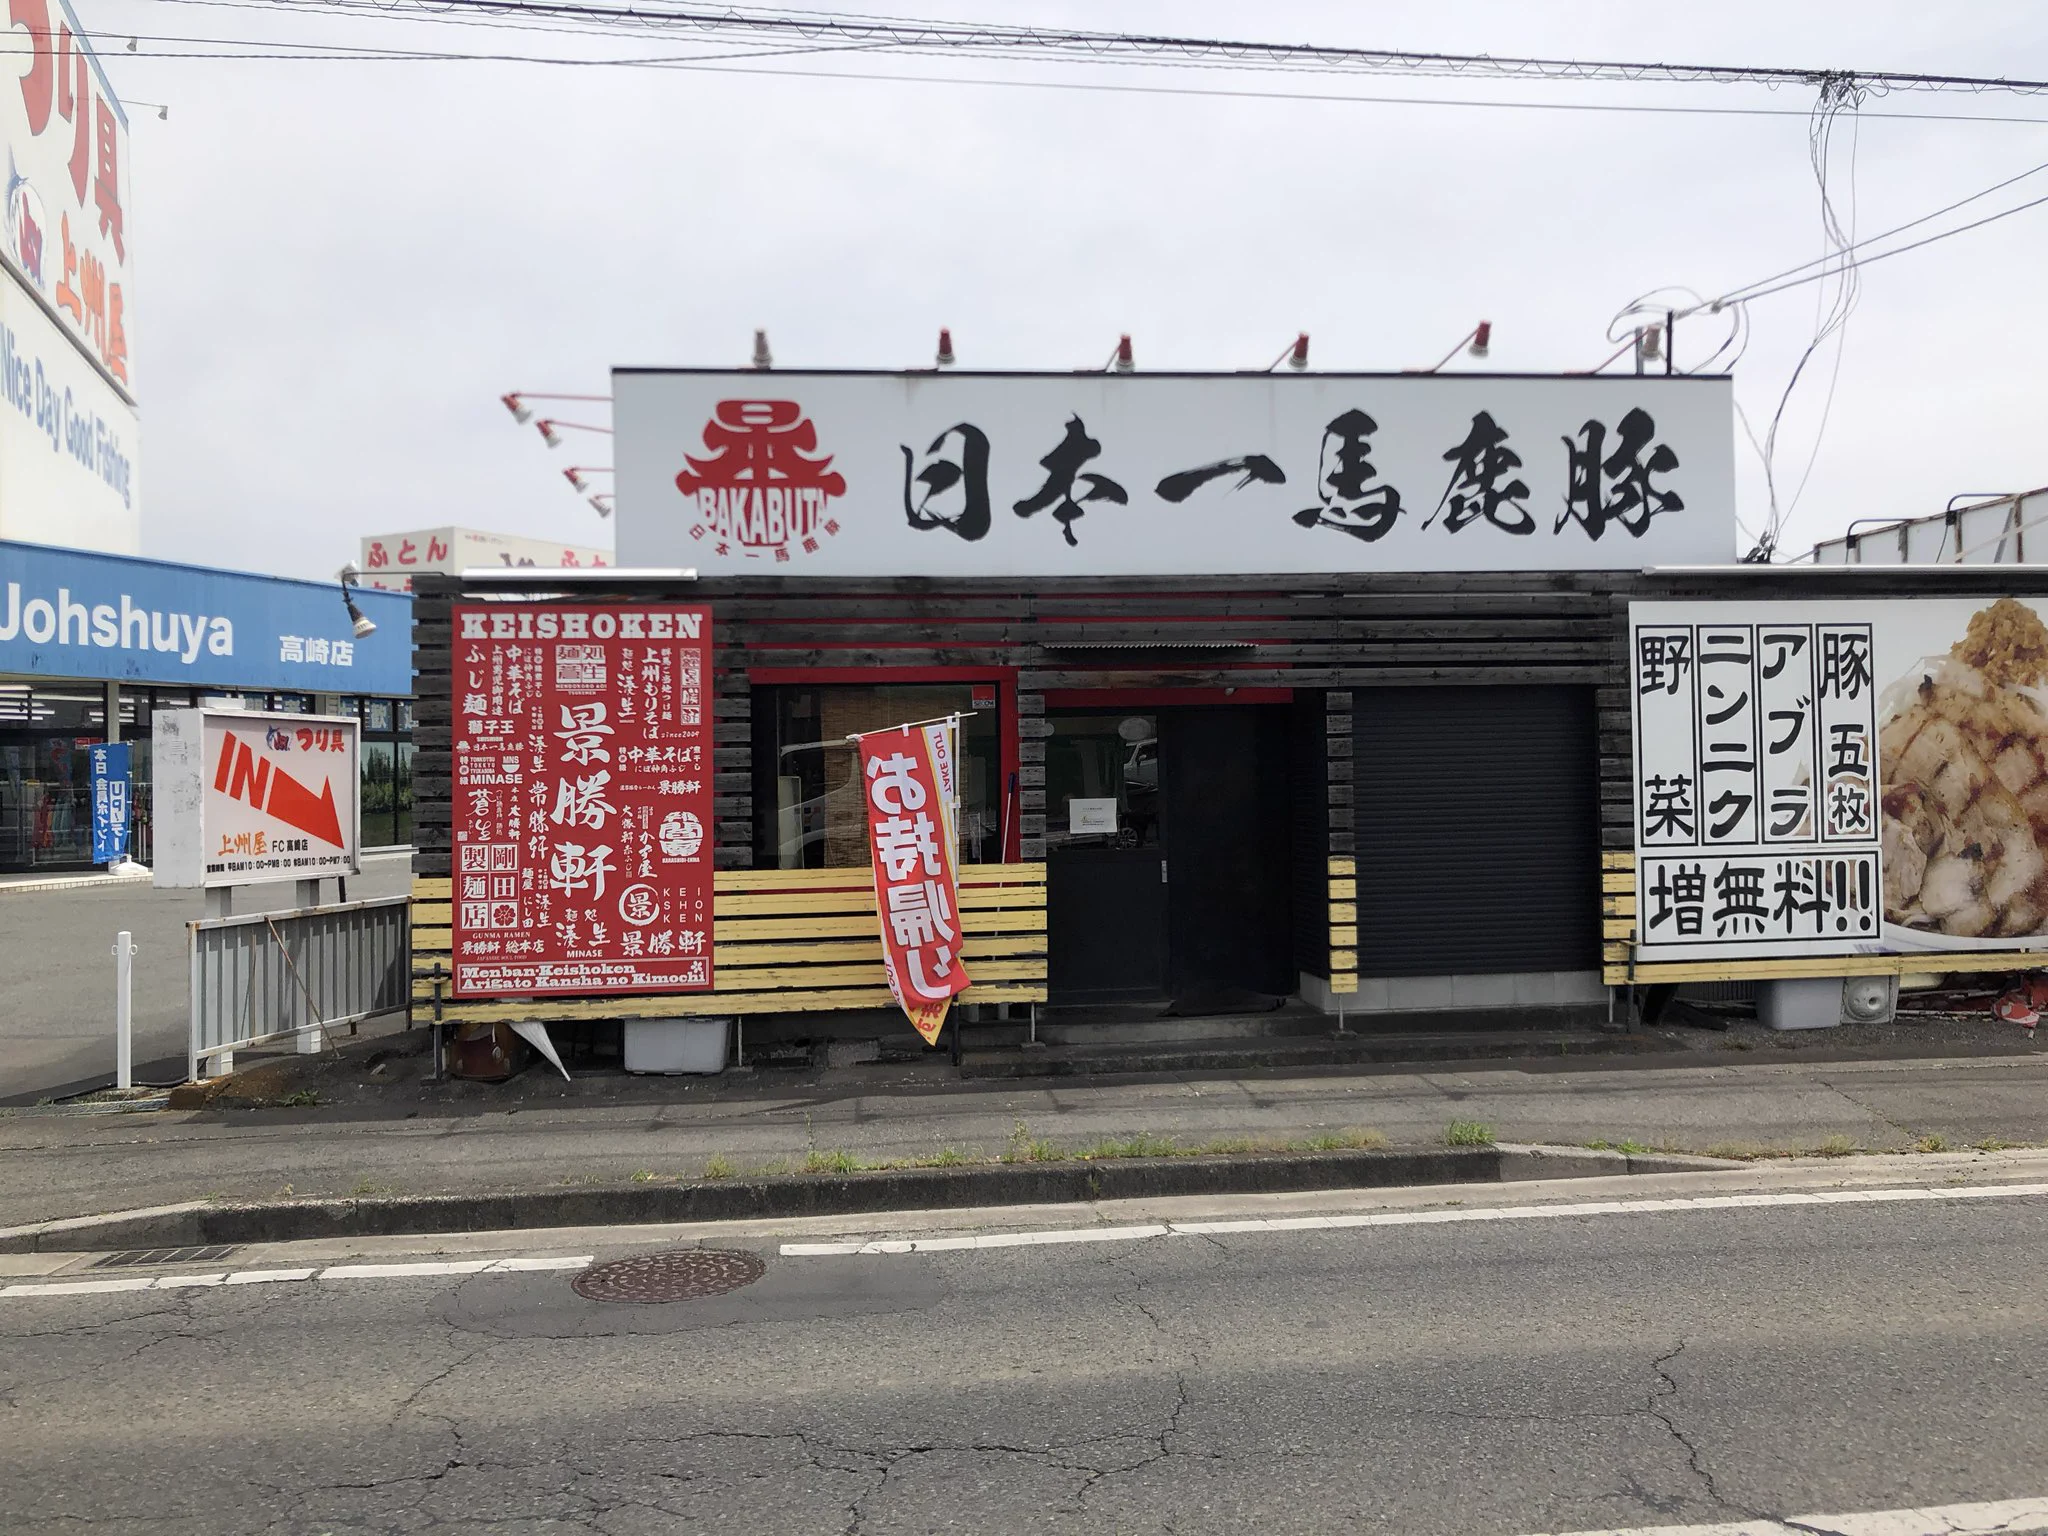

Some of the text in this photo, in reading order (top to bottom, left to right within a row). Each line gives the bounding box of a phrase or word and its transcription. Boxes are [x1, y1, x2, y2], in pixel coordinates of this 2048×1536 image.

[56, 210, 128, 386] 上州屋
[0, 320, 31, 418] Nice
[35, 356, 60, 452] Day
[64, 386, 93, 471] Good
[900, 407, 1686, 546] 日本一馬鹿豚
[368, 536, 448, 569] ふとん
[0, 583, 234, 664] Johshuya
[461, 613, 703, 640] KEISHOKEN
[279, 635, 354, 667] 高崎店
[463, 644, 488, 716] ふじ麺
[506, 644, 525, 715] 中華そば
[641, 647, 661, 740] 上州もりそば
[296, 728, 345, 752] つり具
[627, 746, 693, 763] 中華そば
[1640, 635, 1695, 838] 野菜
[1699, 634, 1755, 839] ニンニク
[1762, 633, 1811, 837] アブラ
[214, 730, 271, 811] IN
[470, 774, 523, 784] MINASE
[658, 780, 702, 795] 景勝軒
[549, 701, 618, 902] 景勝軒
[218, 831, 267, 857] 上州屋
[272, 840, 285, 853] FC
[463, 846, 487, 928] 製麺店
[627, 892, 653, 918] 景
[1648, 859, 1873, 939] 増無料!!
[461, 939, 545, 955] 景勝軒 総本店
[566, 949, 603, 958] MINASE
[620, 929, 707, 957] 景勝軒
[461, 971, 706, 991] Arigato Kansha no Kimochi
